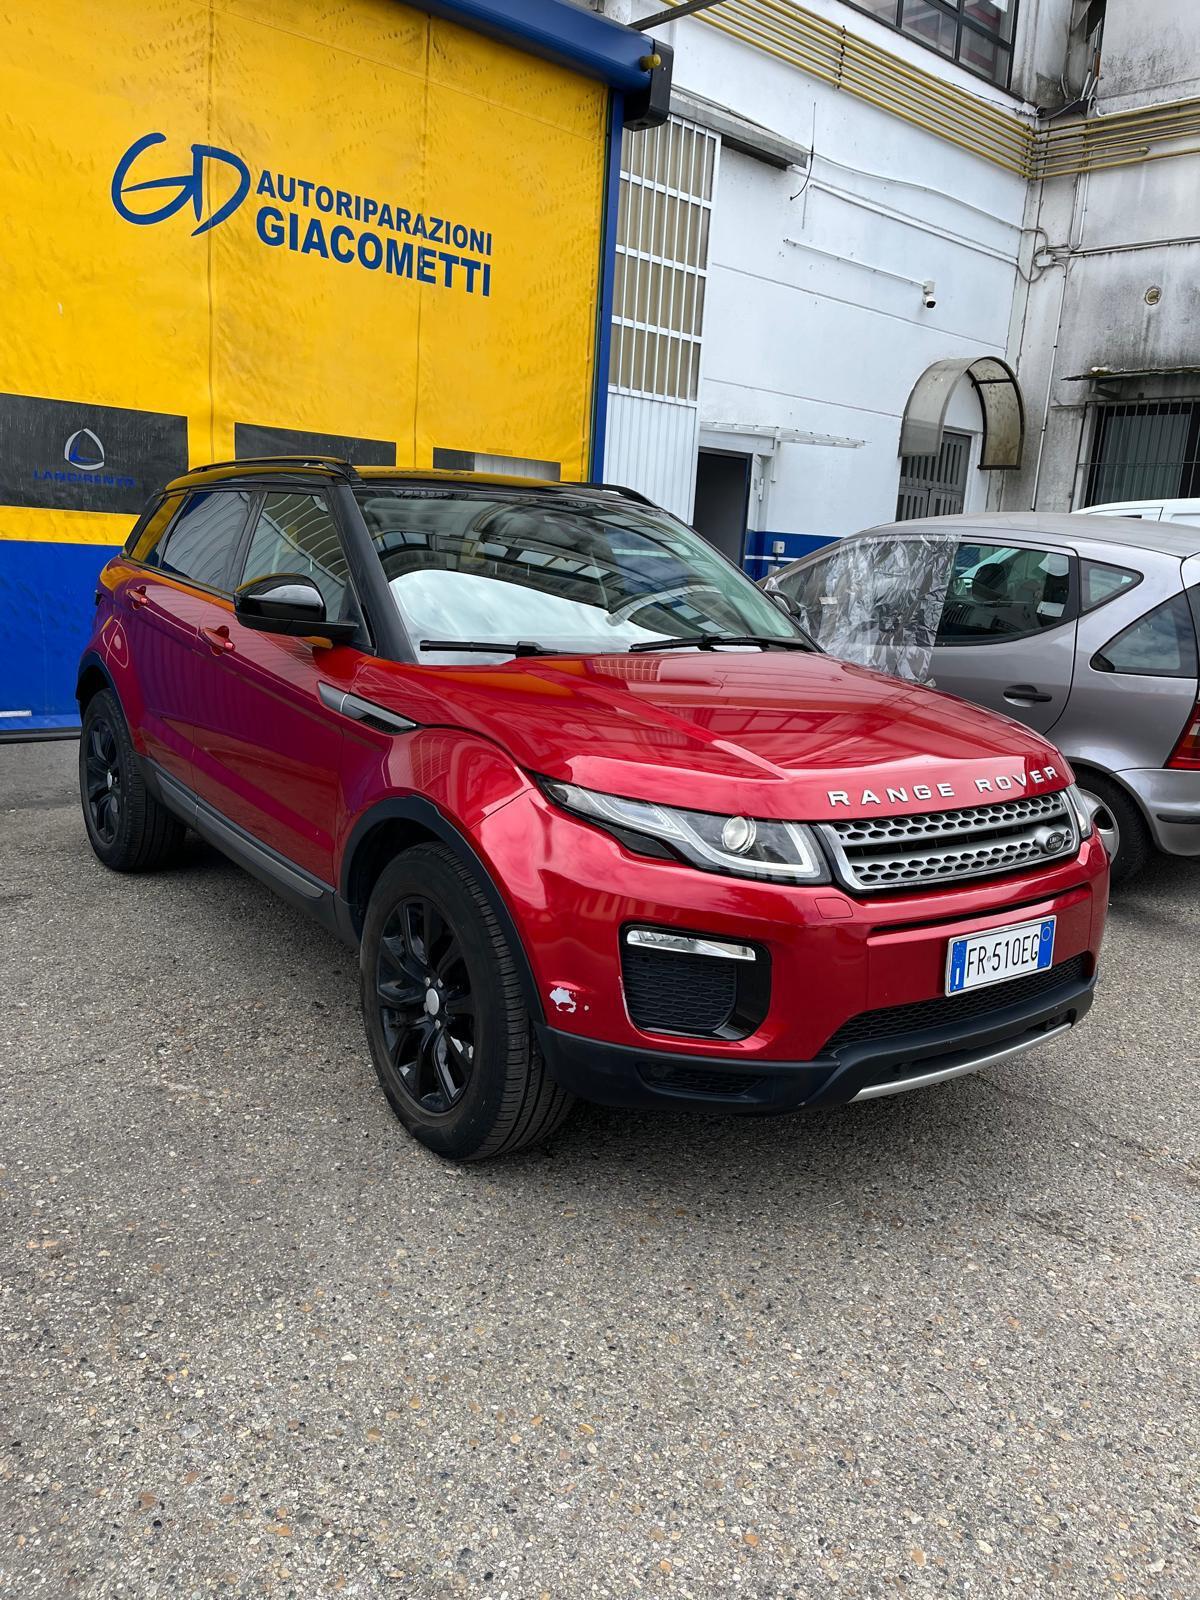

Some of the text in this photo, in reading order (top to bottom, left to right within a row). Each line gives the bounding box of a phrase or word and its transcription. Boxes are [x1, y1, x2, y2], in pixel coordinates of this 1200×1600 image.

[256, 170, 493, 256] AUTORIPARAZIONI
[256, 206, 491, 297] GIACOMETTI
[827, 765, 1059, 807] RANGE ROVER
